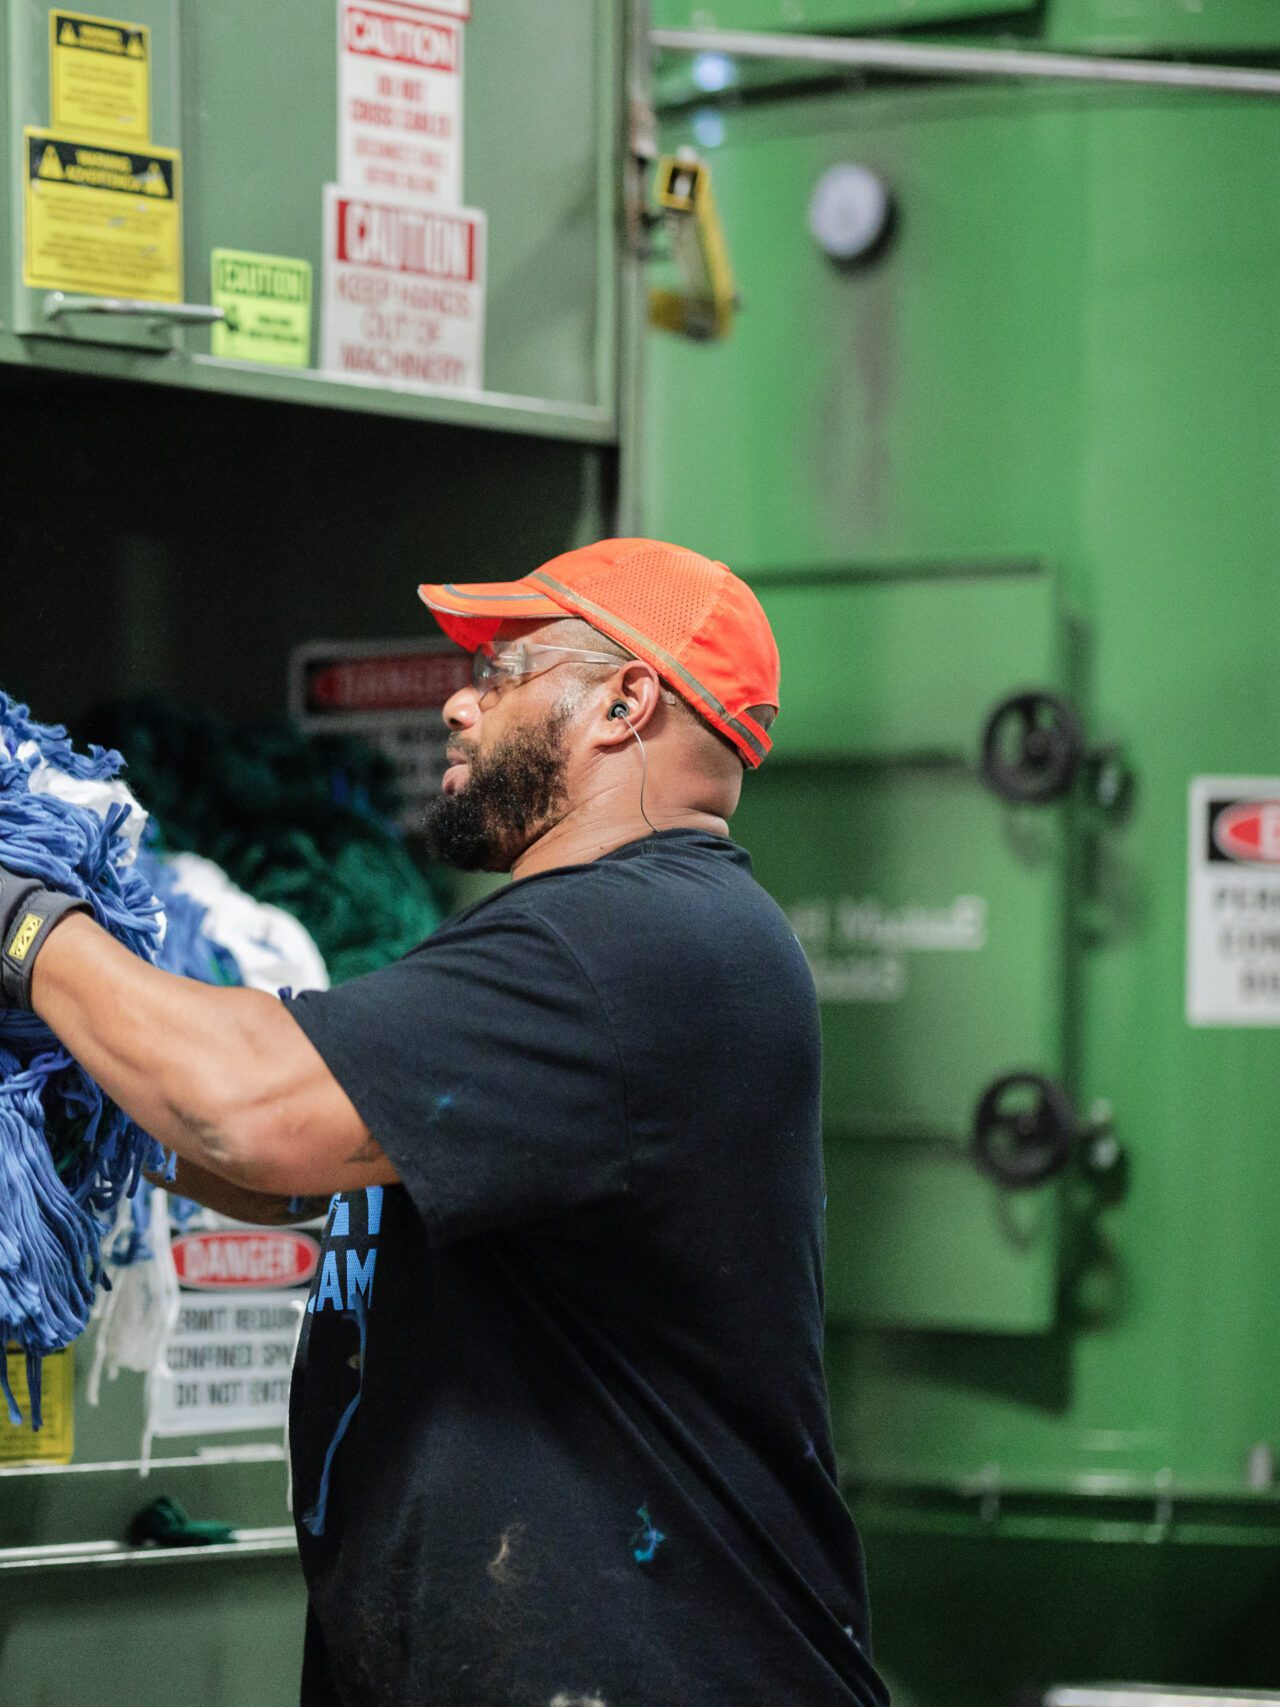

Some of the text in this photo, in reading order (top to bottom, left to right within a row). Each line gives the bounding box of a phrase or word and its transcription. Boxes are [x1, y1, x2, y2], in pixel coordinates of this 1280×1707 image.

[350, 11, 451, 67] CAUTION
[346, 201, 468, 280] CAUTION
[222, 261, 302, 300] CAUTION
[185, 1239, 295, 1281] DANGER
[308, 1249, 377, 1313] AM
